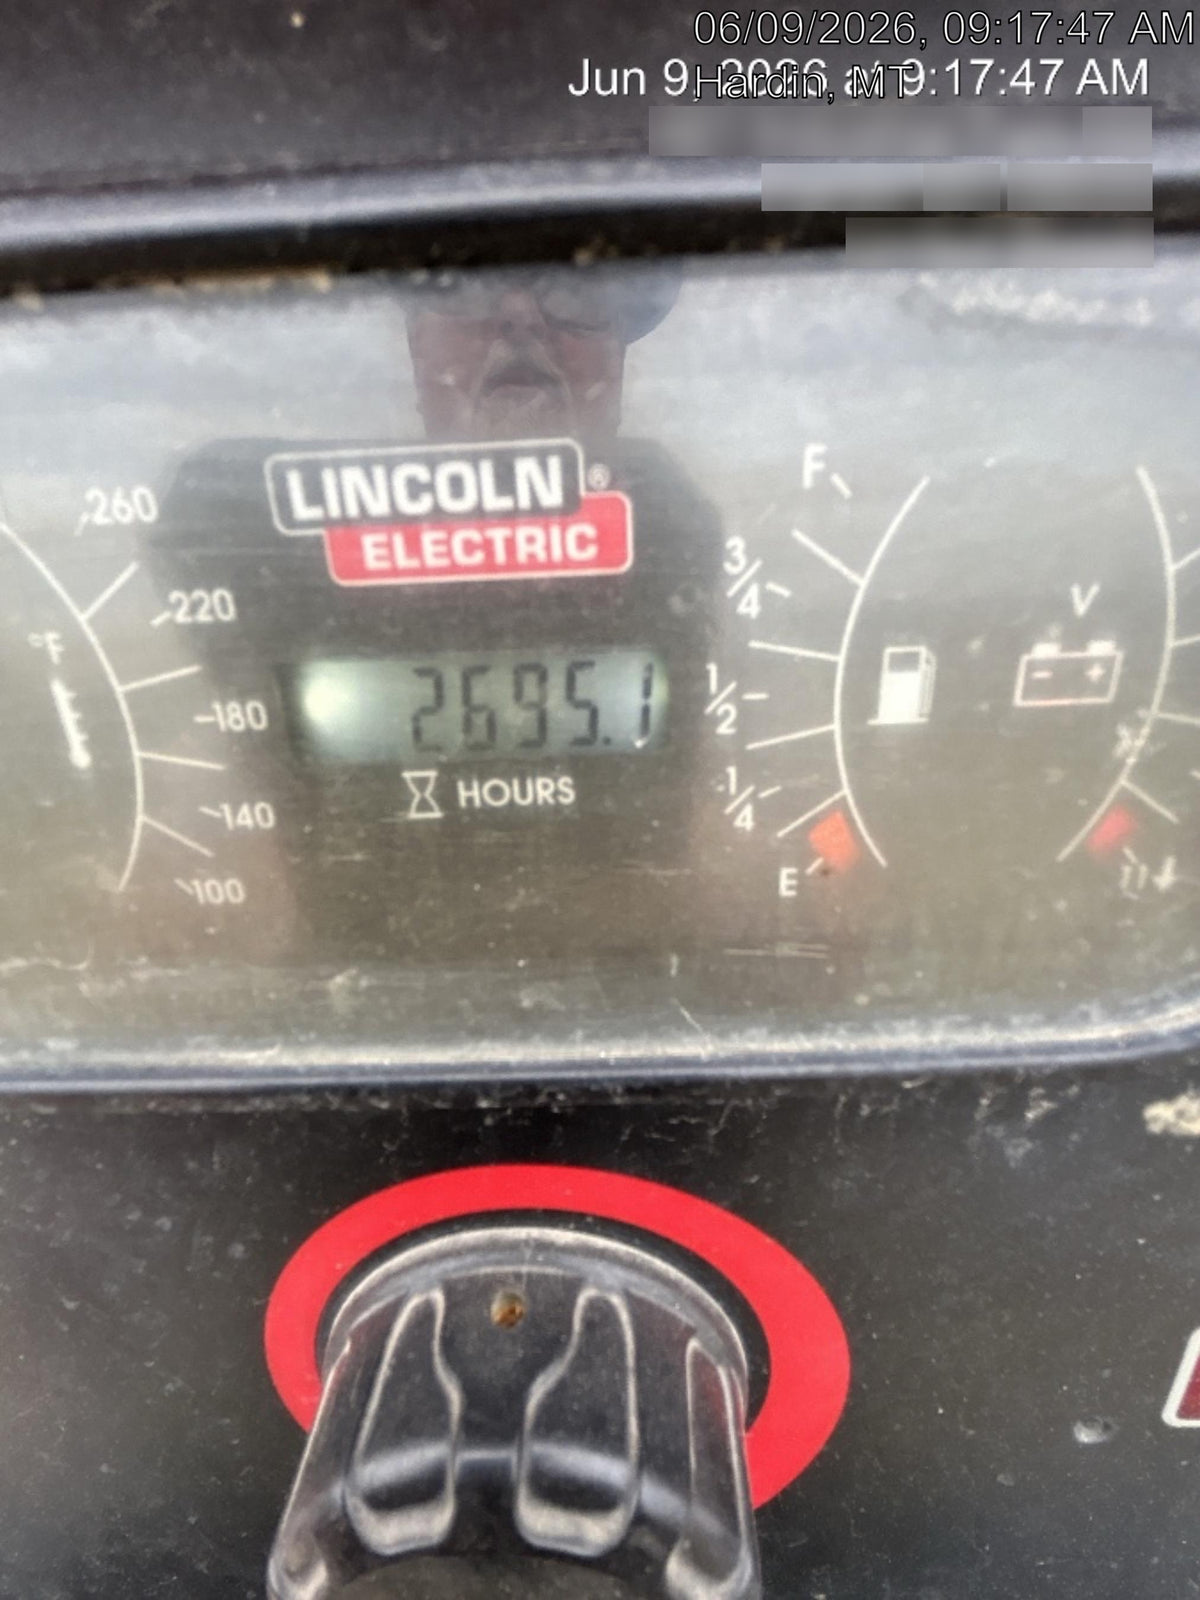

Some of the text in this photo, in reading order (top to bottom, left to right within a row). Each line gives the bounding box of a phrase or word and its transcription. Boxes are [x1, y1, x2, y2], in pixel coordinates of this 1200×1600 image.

[802, 443, 827, 489] F
[86, 485, 158, 526] 260
[286, 454, 564, 522] LINCOLN
[361, 522, 600, 571] ELECTRIC
[168, 587, 236, 624] 220
[211, 699, 268, 733] 180
[411, 658, 654, 752] 2695.1
[456, 776, 576, 809] HOURS
[219, 801, 276, 830] 140
[190, 878, 246, 905] 100
[778, 867, 799, 897] E
